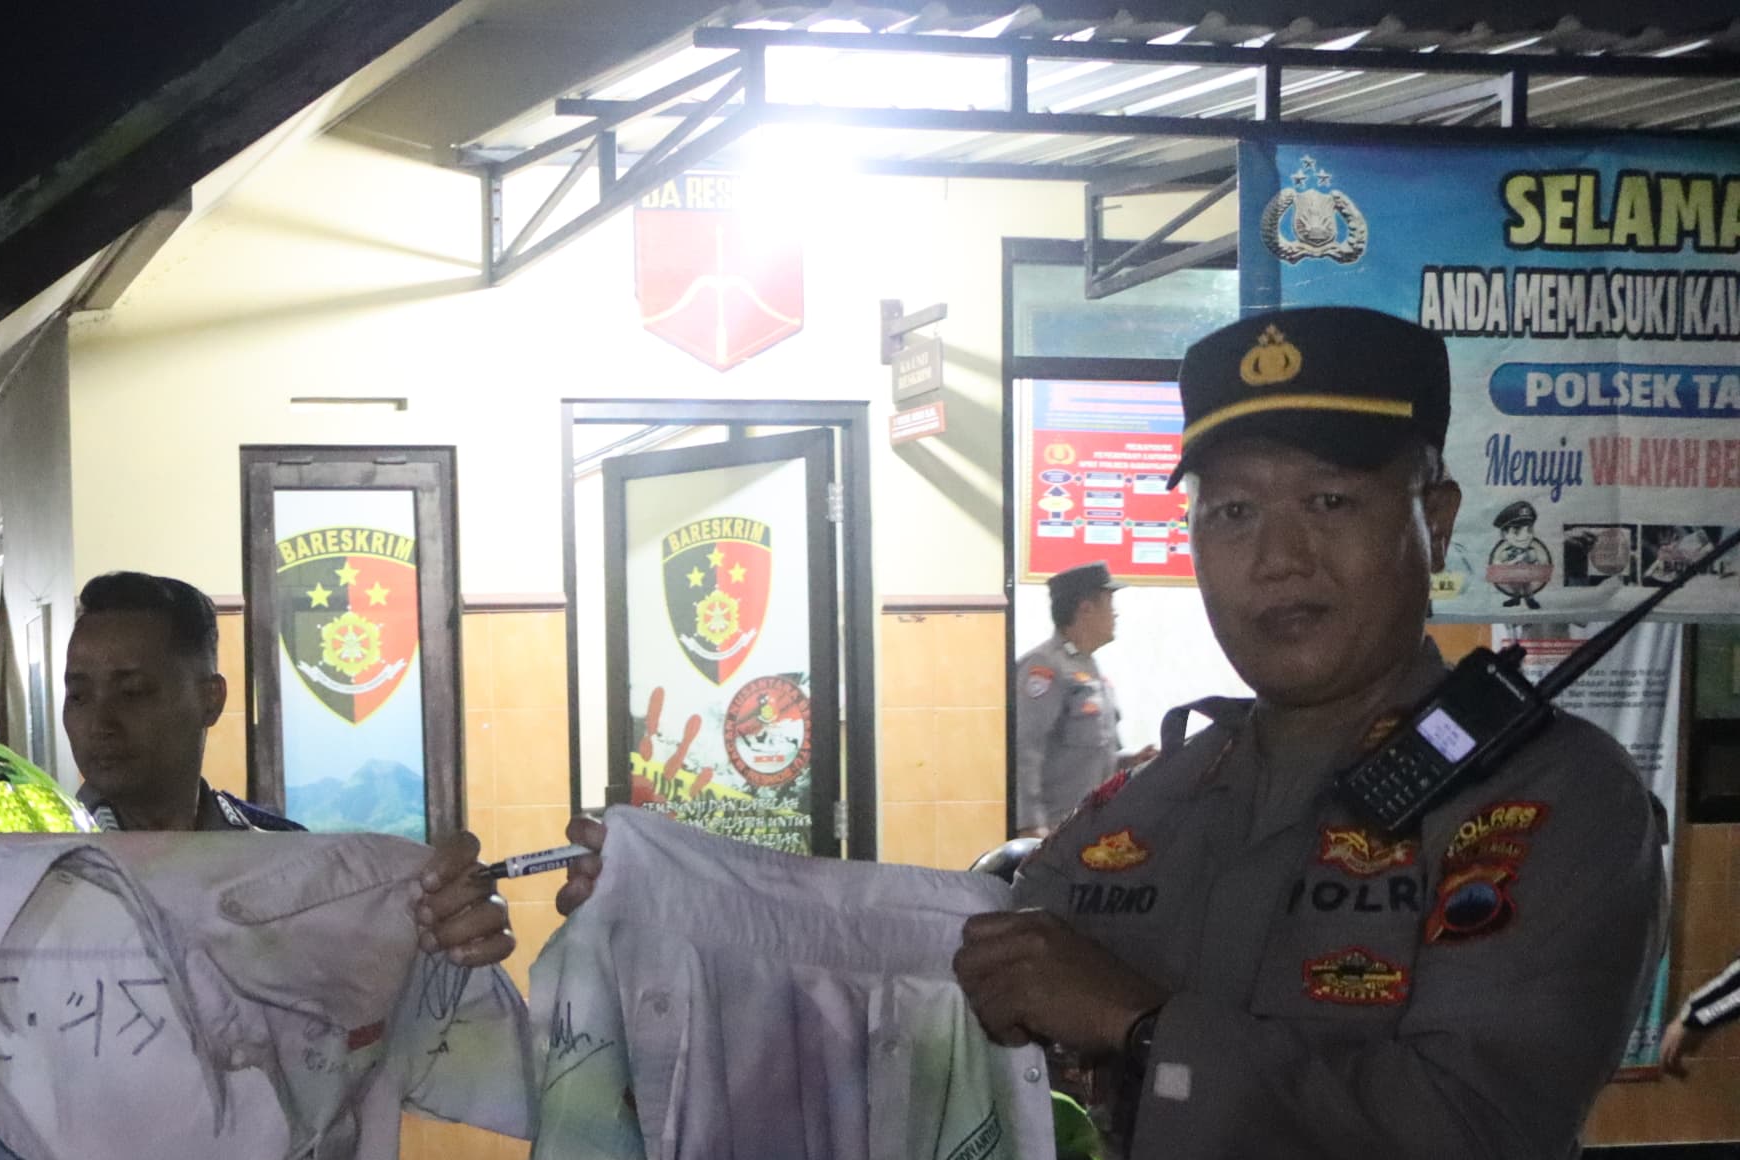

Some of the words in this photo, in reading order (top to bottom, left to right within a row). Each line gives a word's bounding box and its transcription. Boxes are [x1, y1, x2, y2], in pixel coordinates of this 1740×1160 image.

[1419, 269, 1509, 335] ANDA
[1512, 269, 1679, 337] MEMASUKI
[1525, 371, 1681, 410] POLSEK
[1485, 433, 1583, 503] Menuju
[1588, 436, 1701, 488] WILAYAH
[278, 529, 415, 564] BARESKRIM
[668, 518, 765, 552] BARESKRIM
